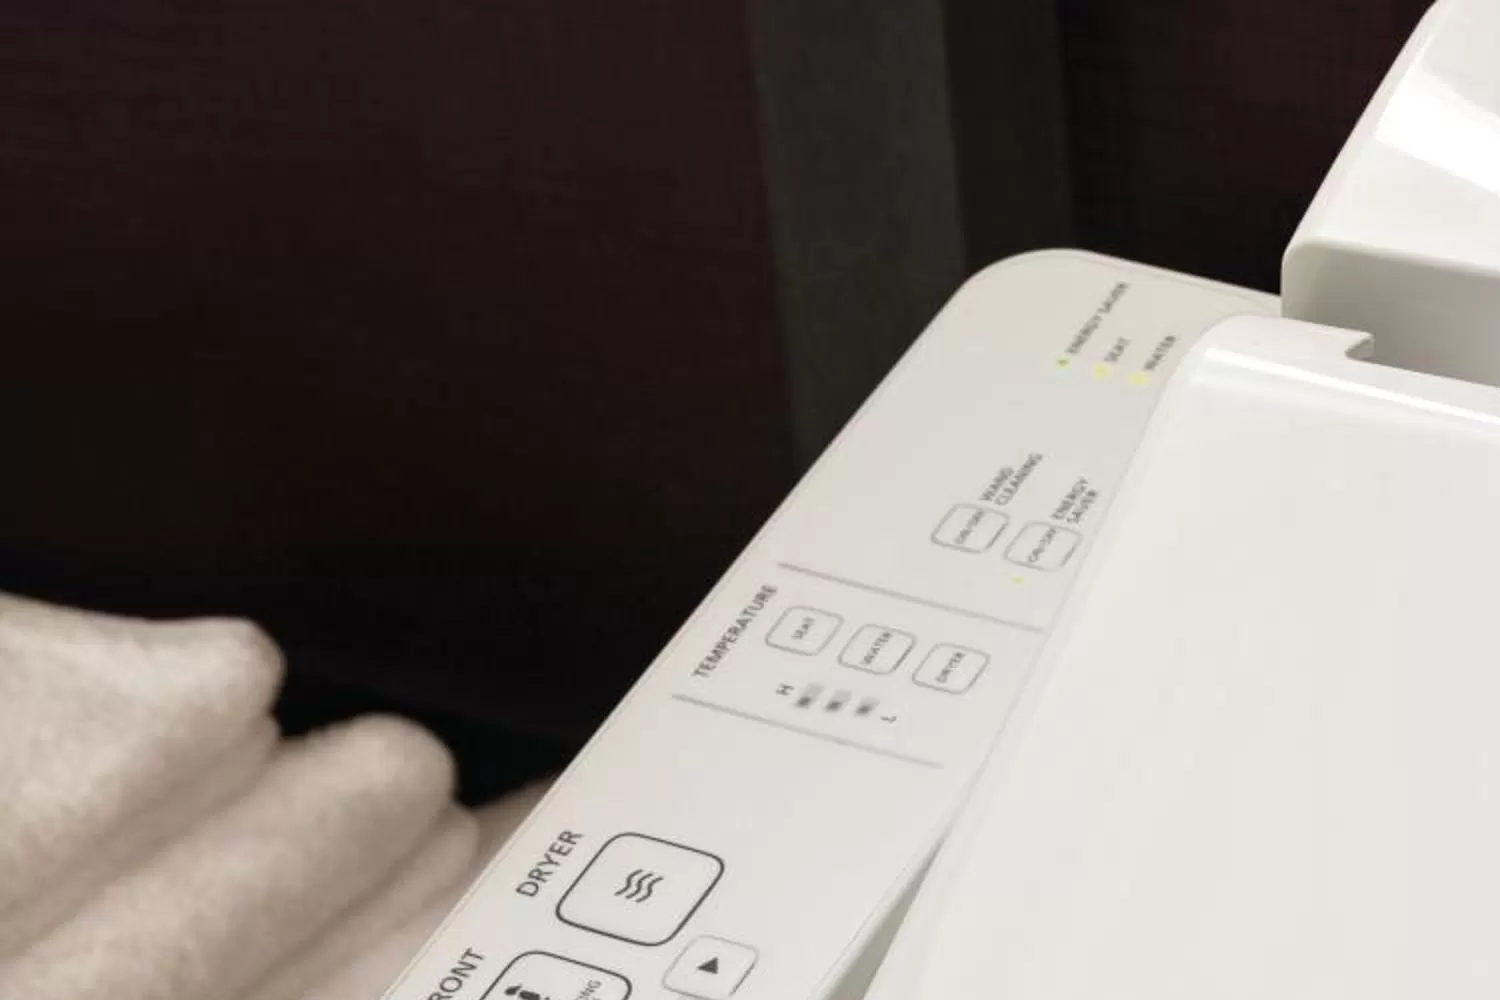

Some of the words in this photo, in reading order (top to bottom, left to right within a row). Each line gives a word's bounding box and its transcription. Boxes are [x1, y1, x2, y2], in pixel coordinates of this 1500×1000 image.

[690, 583, 777, 679] TEMPERATURE
[775, 683, 795, 697] H
[515, 829, 584, 898] DRYER
